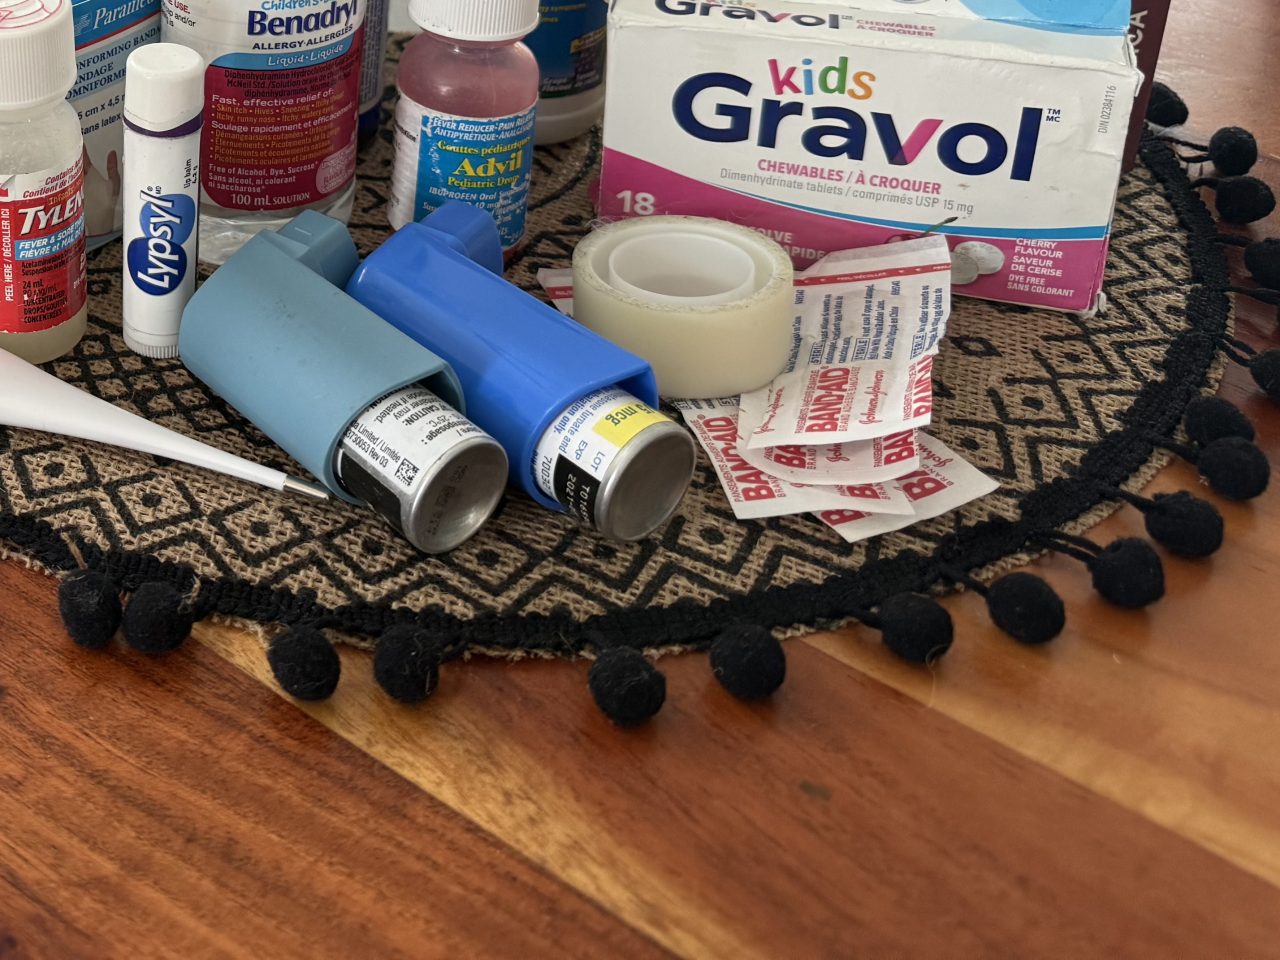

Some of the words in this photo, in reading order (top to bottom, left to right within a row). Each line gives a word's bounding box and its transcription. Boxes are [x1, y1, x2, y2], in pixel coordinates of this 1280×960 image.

[174, 0, 190, 14] USE.
[175, 13, 196, 27] and/or
[252, 40, 304, 50] ALLERGY
[305, 23, 353, 47] ALLERGIES
[268, 54, 305, 67] Liquid
[768, 56, 876, 100] kids
[212, 95, 240, 106] Fast,
[243, 98, 294, 107] effective
[296, 93, 321, 104] relief
[323, 89, 334, 98] of:
[1101, 84, 1117, 116] 02384116
[102, 114, 121, 127] latex
[212, 120, 248, 133] Soulage
[251, 123, 302, 133] rapidement
[432, 117, 457, 130] FEVER
[458, 122, 495, 132] REDUCER
[672, 71, 1043, 182] Gravol
[434, 127, 496, 141] ANTIPYRÉTIQUE
[453, 150, 523, 177] Advil
[757, 158, 844, 182] CHEWABLES
[846, 170, 853, 183] /
[855, 169, 869, 185] À
[869, 174, 942, 195] CROQUER
[232, 193, 251, 205] 100
[254, 195, 272, 206] mL
[273, 192, 310, 204] SOLUTION
[429, 186, 476, 200] IBUPROFEN
[479, 192, 496, 200] Oral
[719, 167, 803, 190] Dimenhydrinate
[806, 181, 843, 197] tablets
[851, 190, 914, 206] comprimés
[915, 194, 940, 209] USP
[943, 199, 955, 211] 15
[956, 202, 974, 215] mg
[616, 190, 655, 215] 18
[1, 208, 10, 220] ICI
[2, 220, 11, 257] DÉCOLLER
[20, 239, 47, 250] FEVER
[137, 189, 182, 290] Lypsyl
[1016, 238, 1058, 250] CHERRY
[1015, 246, 1063, 259] FLAVOUR
[1012, 255, 1054, 267] SAVEUR
[4, 263, 13, 283] HERE
[1011, 264, 1025, 272] DE
[1027, 266, 1063, 277] CERISE
[1008, 274, 1024, 283] DYE
[1026, 276, 1046, 285] FREE
[5, 284, 14, 302] PEEL
[1007, 282, 1029, 291] SANS
[1030, 285, 1074, 297] COLORANT
[402, 404, 440, 426] CAUTION:
[605, 406, 637, 426] mcg
[575, 440, 588, 460] EXP
[591, 451, 605, 472] LOT
